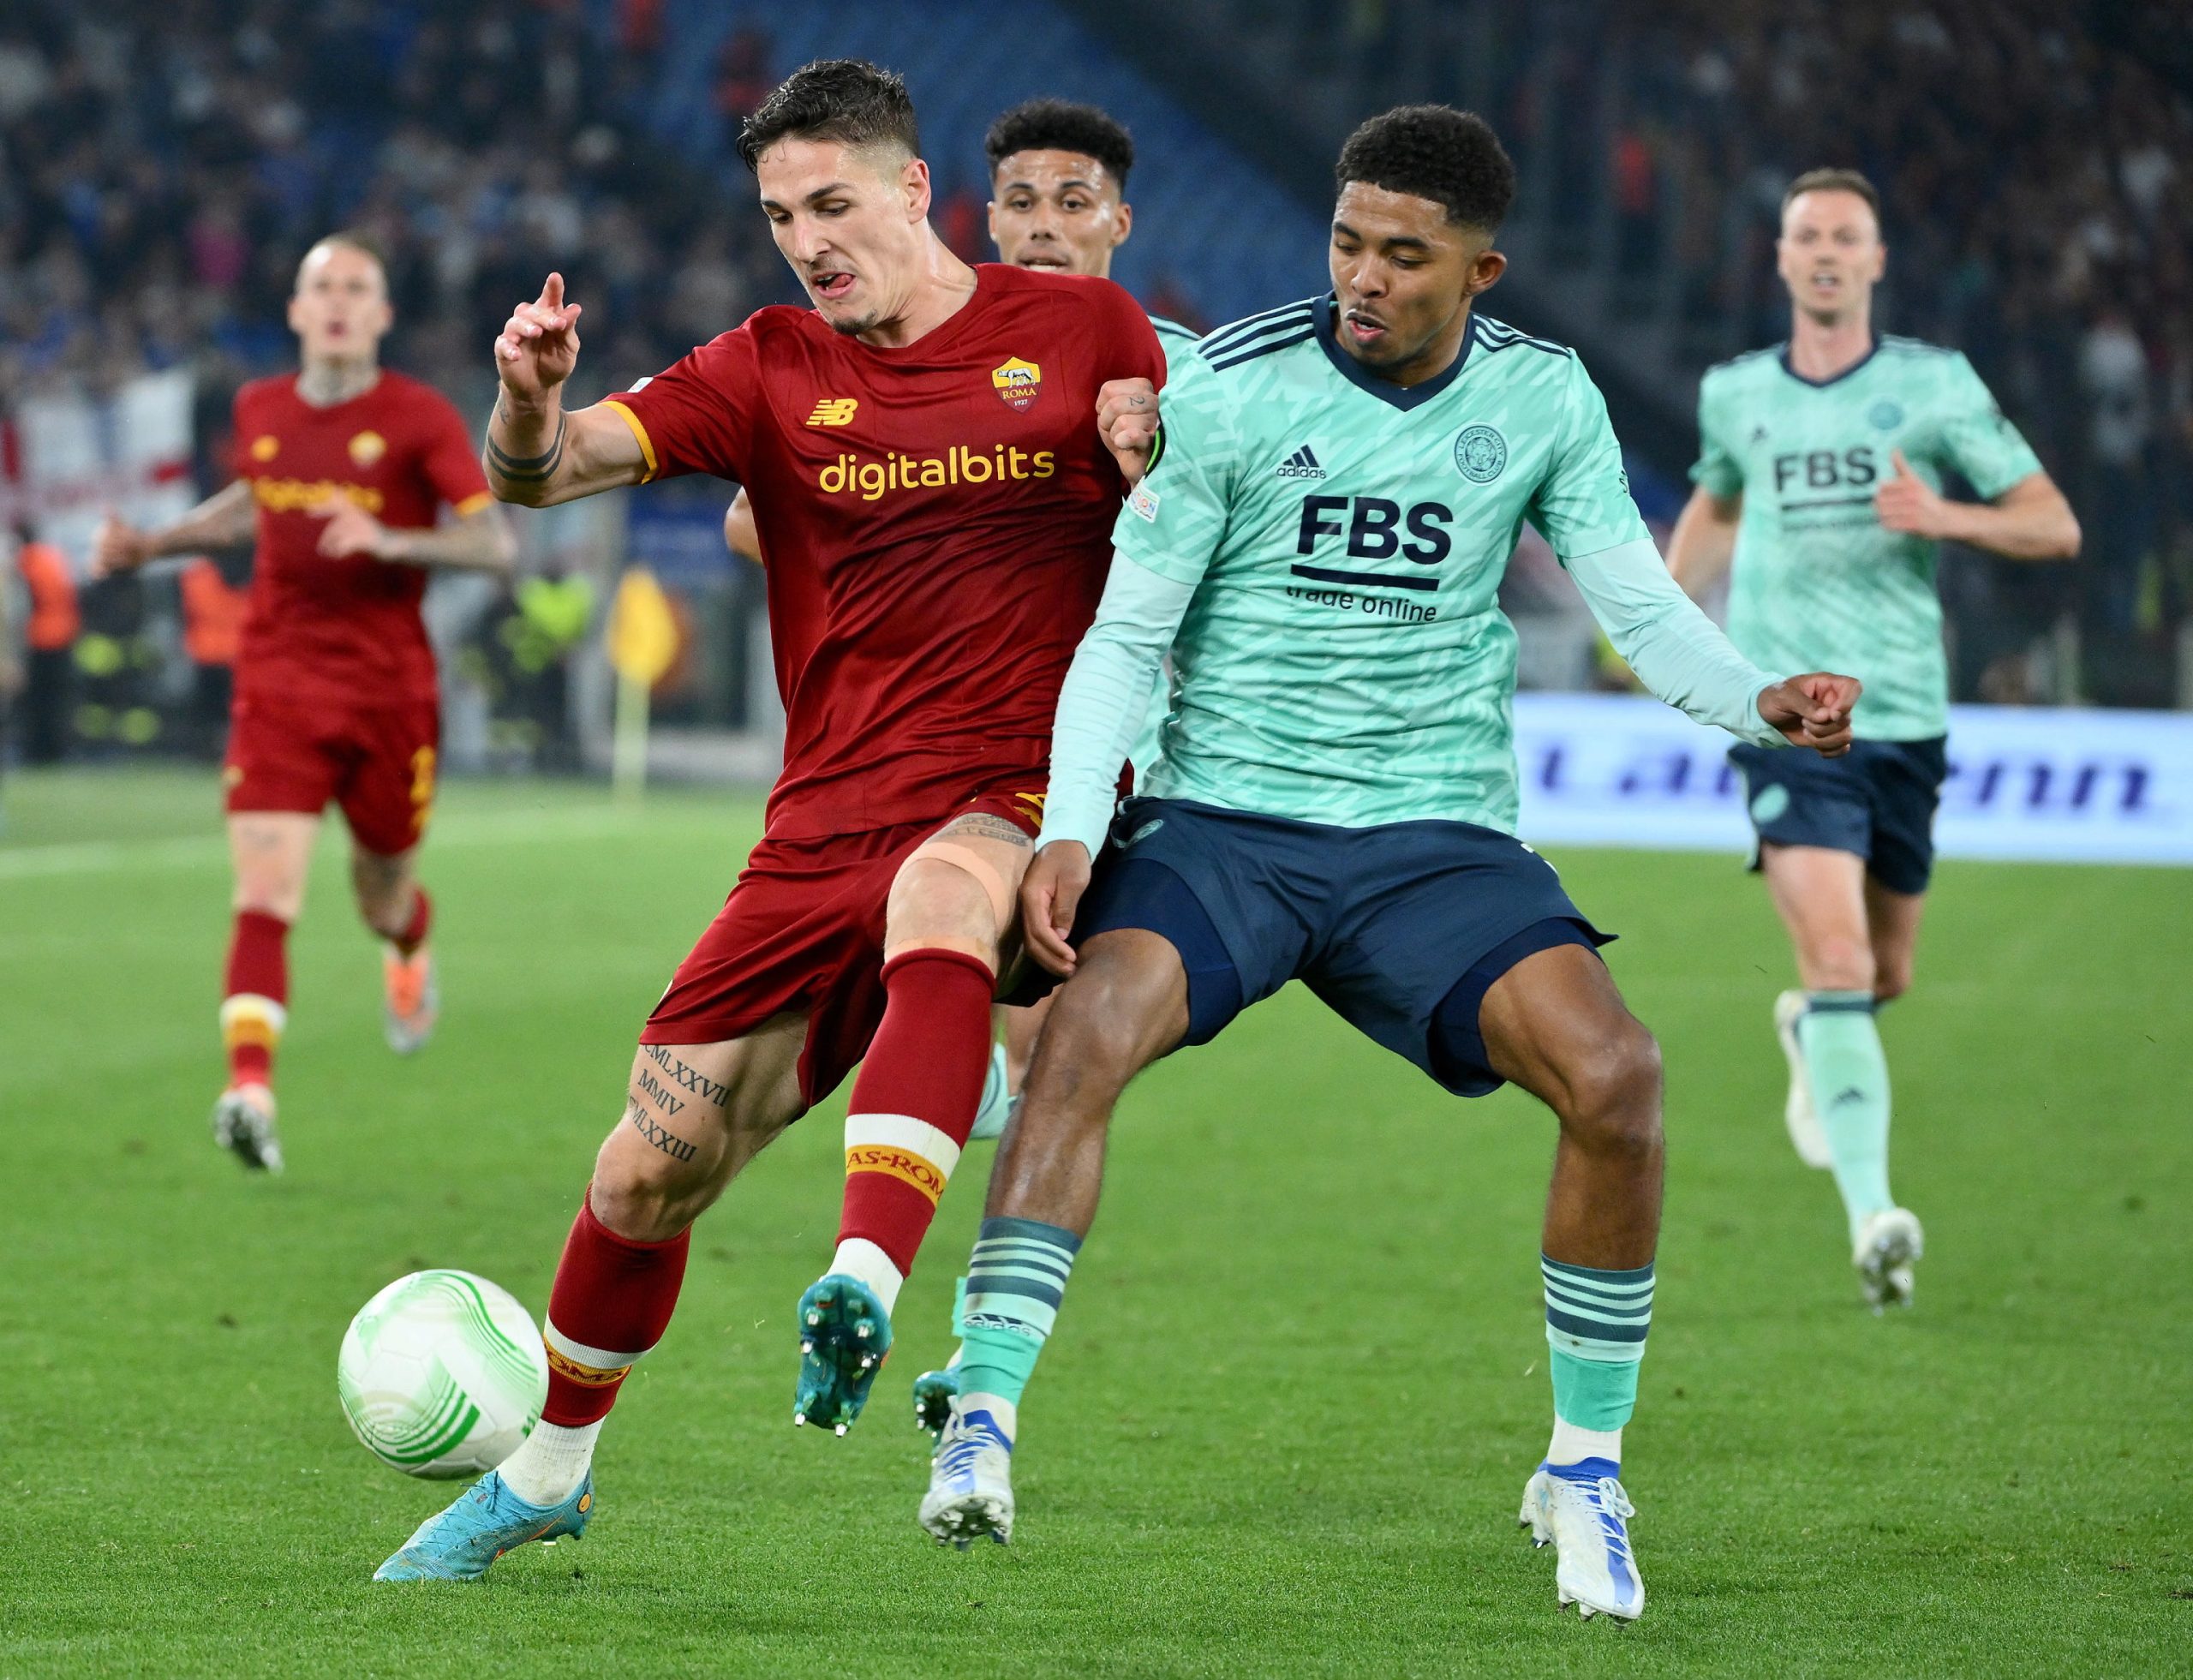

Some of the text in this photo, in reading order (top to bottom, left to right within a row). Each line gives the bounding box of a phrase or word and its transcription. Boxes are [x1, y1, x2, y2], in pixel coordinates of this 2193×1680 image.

[1002, 387, 1037, 399] ROMA
[819, 444, 1055, 500] digitalbits
[1276, 465, 1327, 480] adidas
[1773, 445, 1877, 493] FBS
[1297, 494, 1454, 565] FBS
[1361, 597, 1437, 622] online
[637, 1068, 685, 1116] MMIV
